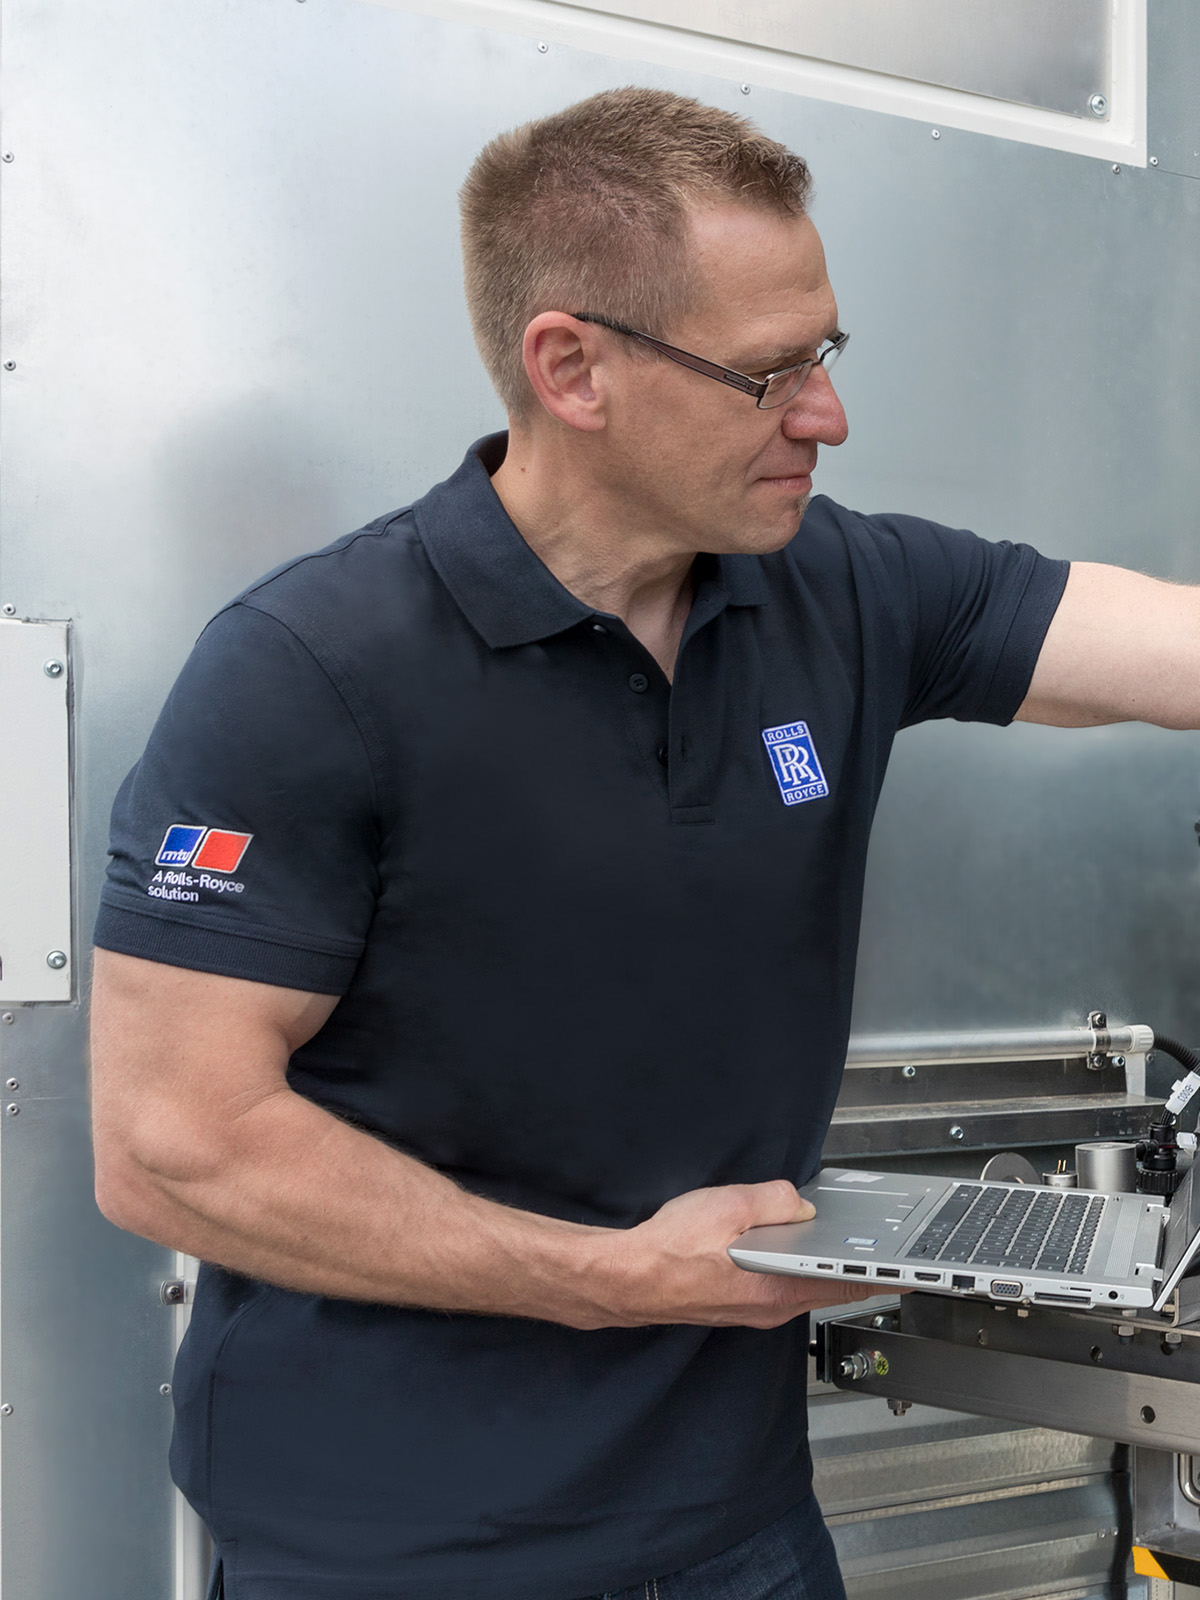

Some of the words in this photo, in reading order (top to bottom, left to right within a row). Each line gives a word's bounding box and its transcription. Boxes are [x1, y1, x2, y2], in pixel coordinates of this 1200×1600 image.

[766, 725, 805, 742] ROLLS
[772, 743, 818, 786] RR
[786, 784, 825, 803] ROYCE
[161, 848, 192, 862] mtu
[152, 870, 164, 883] A
[163, 871, 245, 894] Rolls-Royce
[147, 885, 199, 902] solution
